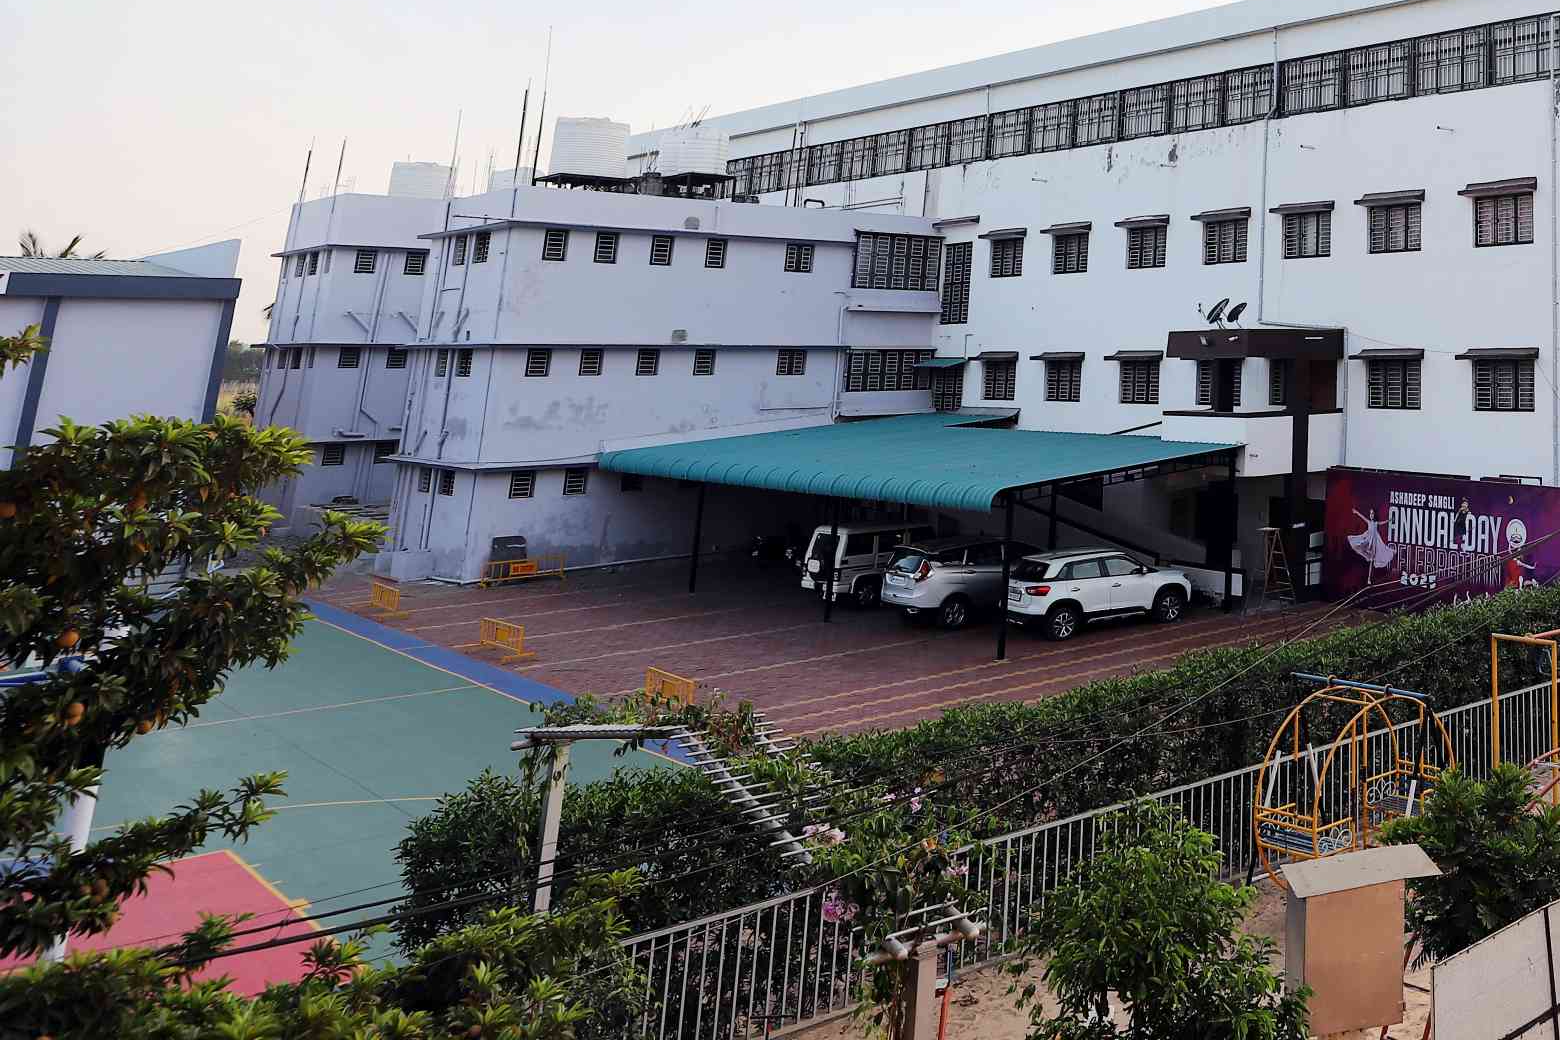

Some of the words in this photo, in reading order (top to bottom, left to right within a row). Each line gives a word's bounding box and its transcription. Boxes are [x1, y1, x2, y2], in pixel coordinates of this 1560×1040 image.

[1390, 491, 1426, 507] ASHADEEP
[1428, 494, 1455, 510] SANGLI
[1388, 506, 1458, 550] ANNUAL
[1461, 513, 1502, 555] DAY
[1400, 571, 1437, 589] 2025
